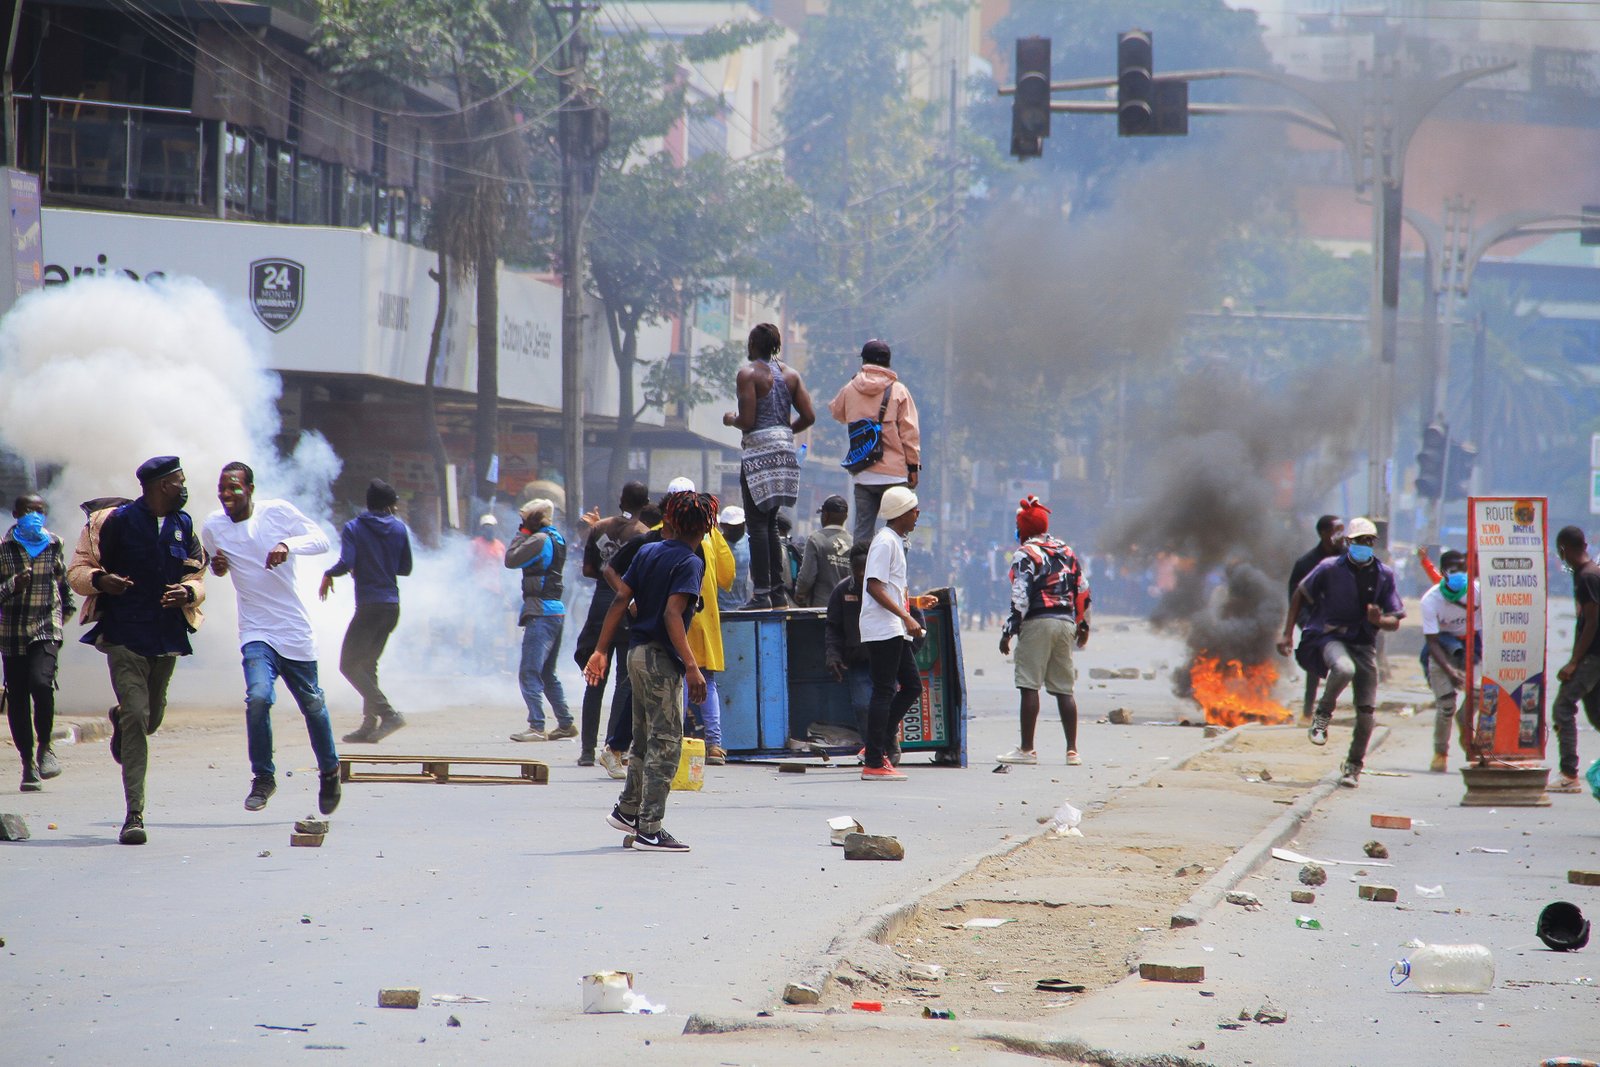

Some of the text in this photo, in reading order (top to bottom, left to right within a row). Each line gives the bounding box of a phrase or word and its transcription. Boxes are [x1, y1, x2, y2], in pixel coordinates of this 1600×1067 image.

[263, 266, 291, 290] 24
[261, 290, 292, 300] MONTH
[1485, 506, 1514, 521] ROUTE
[1488, 574, 1538, 588] WESTLANDS
[1495, 593, 1533, 607] KANGEMI
[1500, 611, 1530, 625] UTHIRU
[1501, 649, 1527, 662] REGEN
[1498, 668, 1528, 681] KIKUYU
